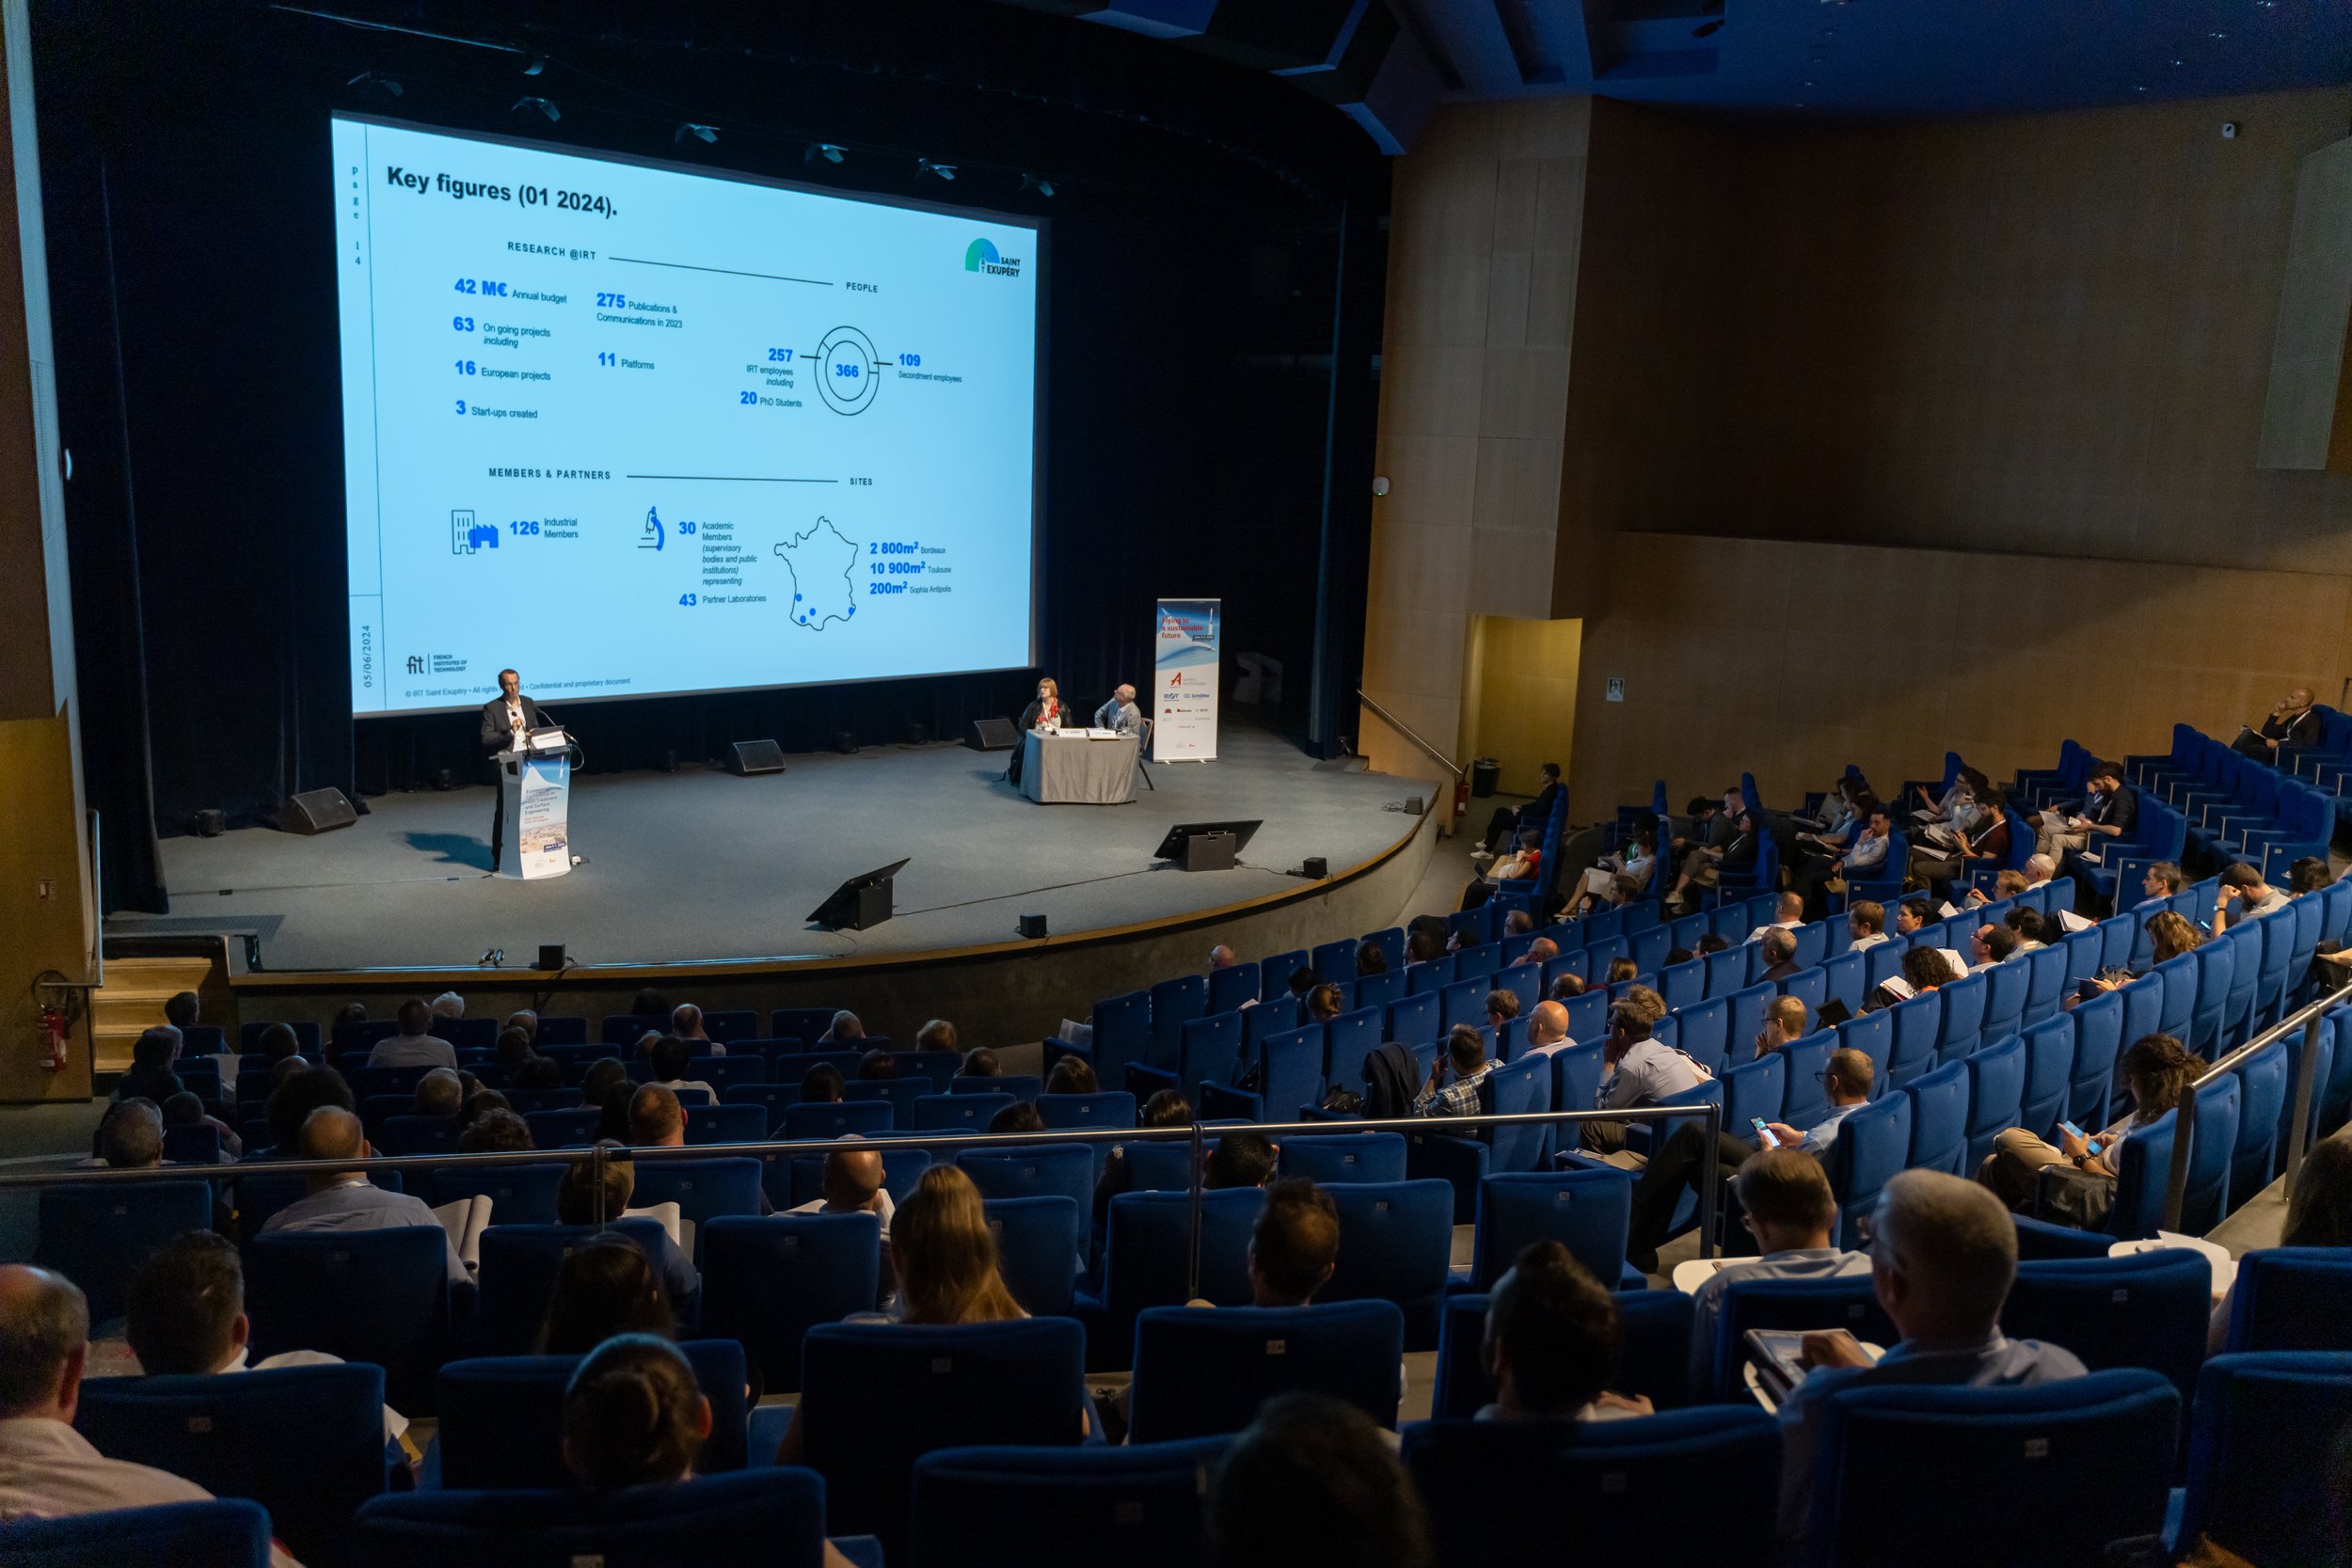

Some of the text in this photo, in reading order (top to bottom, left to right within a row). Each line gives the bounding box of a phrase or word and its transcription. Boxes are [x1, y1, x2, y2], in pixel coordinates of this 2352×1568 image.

[388, 166, 617, 219] Key figures (01 2024).
[507, 242, 596, 261] RESEARCH @IRT
[1001, 256, 1021, 266] SAINT
[987, 264, 1020, 277] EXUPÉRY
[454, 278, 568, 304] 42 M€ Annual budget
[847, 282, 879, 293] PEOPLE
[596, 293, 677, 314] 275 Publications &
[596, 312, 683, 329] Communications in 2023
[453, 317, 551, 339] 63 On going projects
[484, 336, 519, 349] including
[598, 352, 655, 371] 11 Platforms
[769, 348, 794, 362] 257
[899, 354, 921, 367] 109
[455, 360, 551, 382] 16 European projects
[747, 365, 794, 377] IRT employees
[835, 363, 859, 378] 366
[766, 378, 794, 388] including
[898, 371, 961, 384] Secondment employees
[741, 391, 802, 408] 20 PhD Students
[455, 400, 538, 419] 3 Start-ups created
[489, 467, 612, 480] MEMBERS & PARTNERS
[510, 517, 578, 535] 126 Industrial
[679, 521, 734, 534] 30 Academic
[544, 530, 580, 539] Members
[702, 532, 733, 541] Members
[702, 544, 741, 553] (supervisory
[869, 542, 878, 555] 2
[702, 555, 758, 564] bodies and public
[702, 566, 739, 575] institutions)
[870, 562, 885, 574] 10
[702, 578, 743, 587] representing
[910, 585, 928, 594] Sophia
[930, 585, 952, 594] Antipolis
[679, 593, 767, 607] 43 Partner Laboratories
[361, 625, 373, 689] 05/06/2024
[406, 655, 424, 674] fit
[529, 681, 563, 690] Confidential
[575, 679, 604, 689] proprietary
[442, 689, 467, 697] Exupéry
